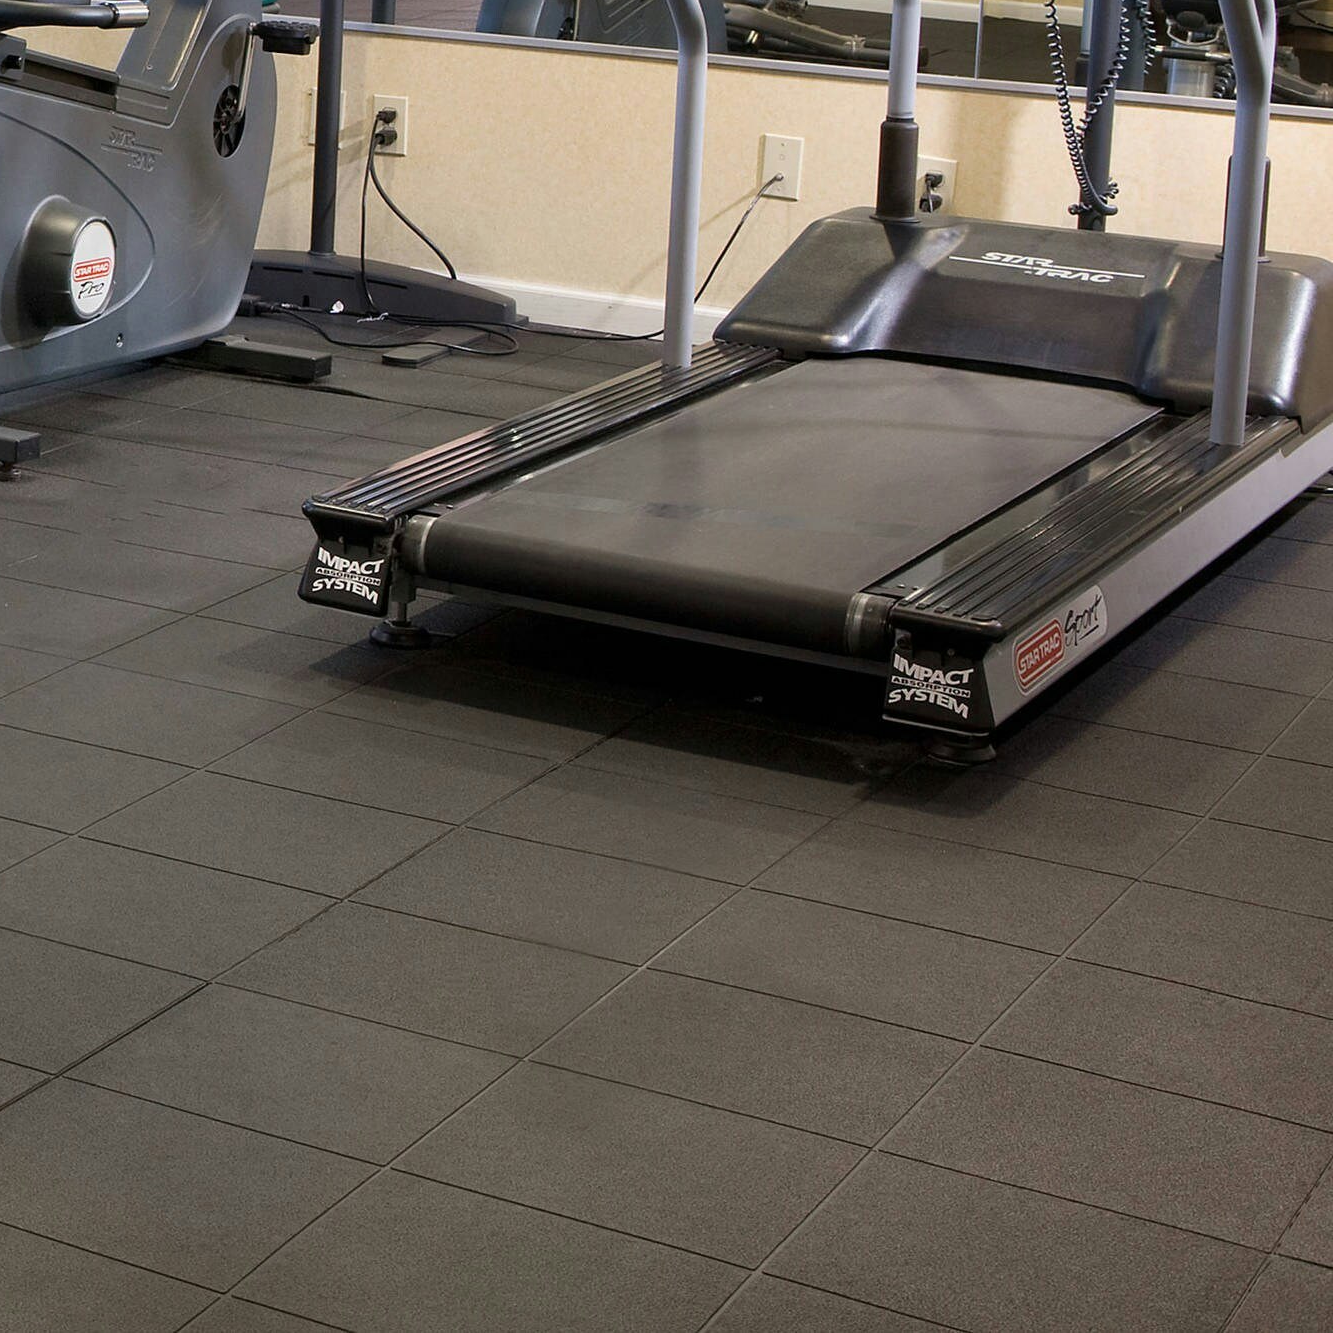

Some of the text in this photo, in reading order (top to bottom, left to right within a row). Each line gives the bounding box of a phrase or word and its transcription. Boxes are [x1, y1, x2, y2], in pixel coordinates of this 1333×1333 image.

[75, 266, 91, 277] STAR
[980, 251, 1055, 268] STAR
[1024, 267, 1115, 284] TRAC
[78, 281, 104, 299] Pro
[317, 546, 385, 575] IMPACT
[315, 566, 382, 587] ABSORPTION
[311, 577, 379, 605] SYSTEM
[1019, 647, 1041, 675] STAR
[1039, 632, 1061, 661] TRAC
[893, 653, 975, 685] IMPACT
[891, 675, 972, 699] ABSORPTION
[888, 688, 969, 720] SYSTEM
